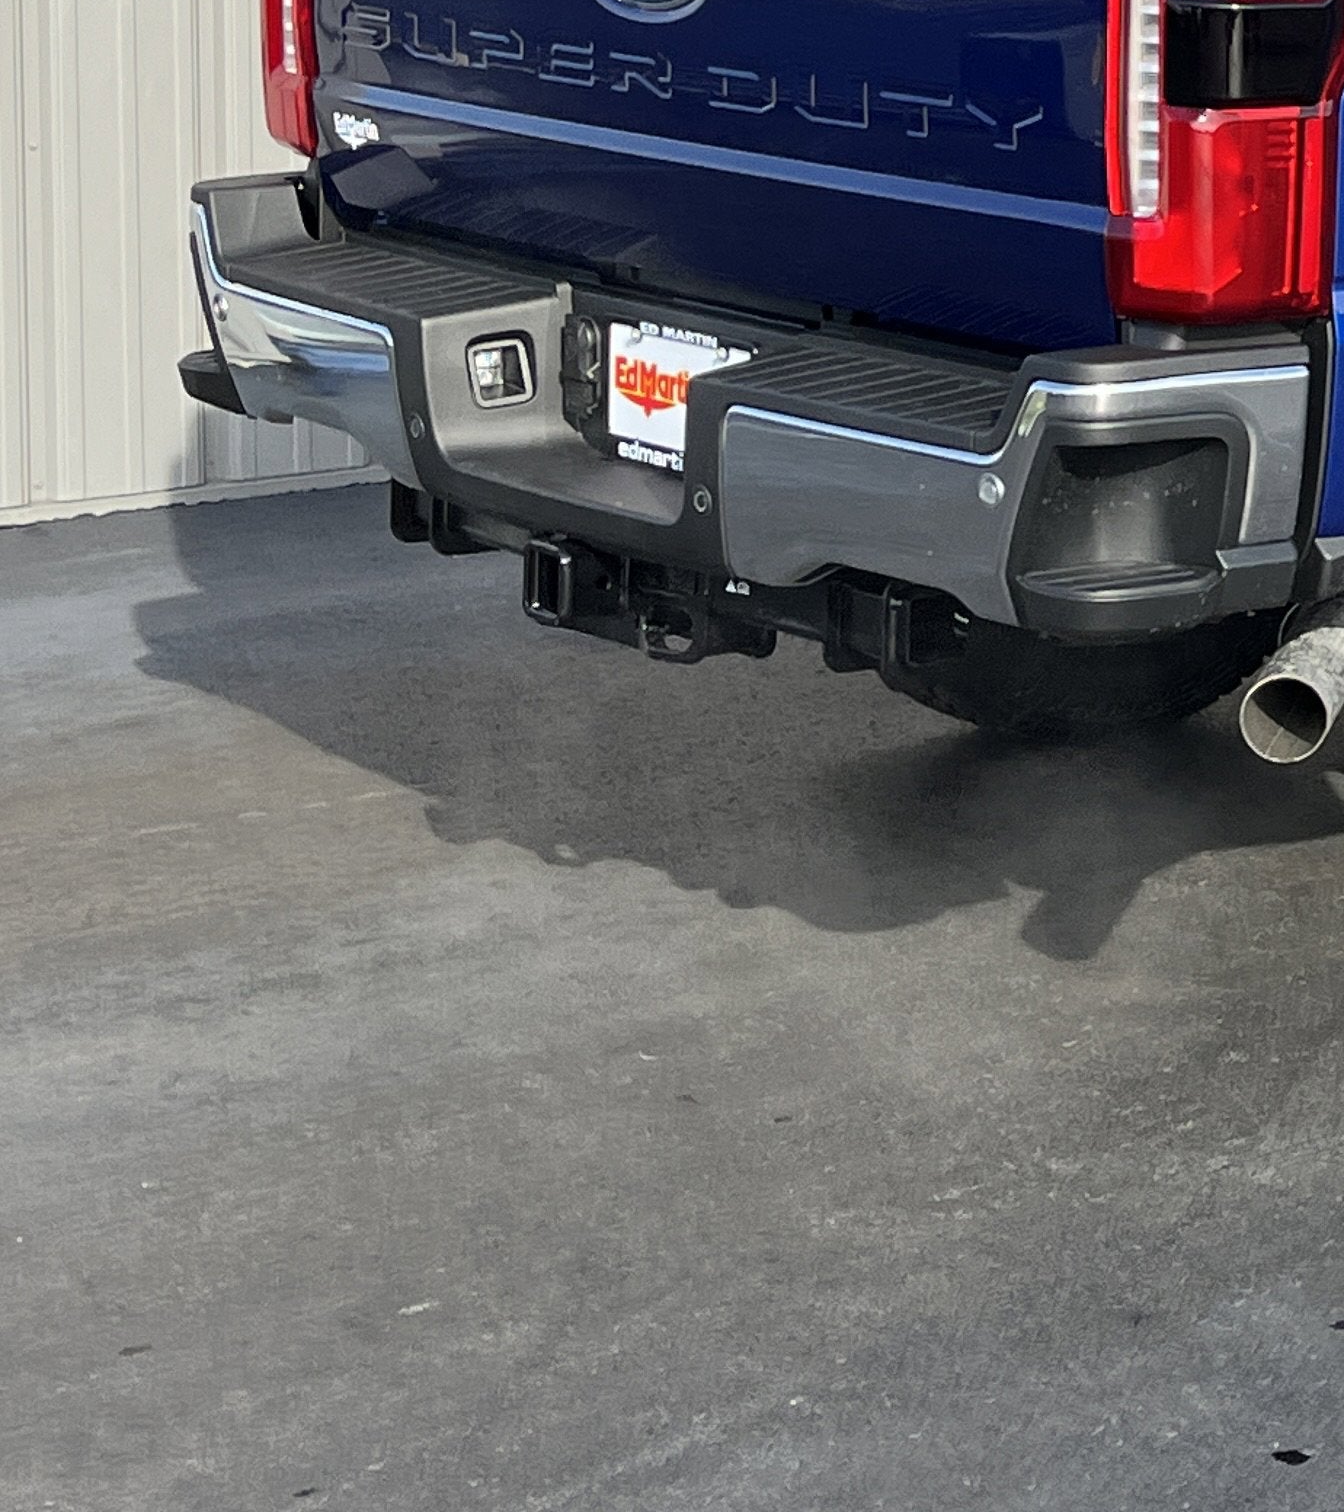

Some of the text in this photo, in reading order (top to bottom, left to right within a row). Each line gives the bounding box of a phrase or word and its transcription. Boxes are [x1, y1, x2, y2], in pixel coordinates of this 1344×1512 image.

[341, 2, 1044, 150] SUPER DUTY
[641, 321, 718, 348] ED MARTIN
